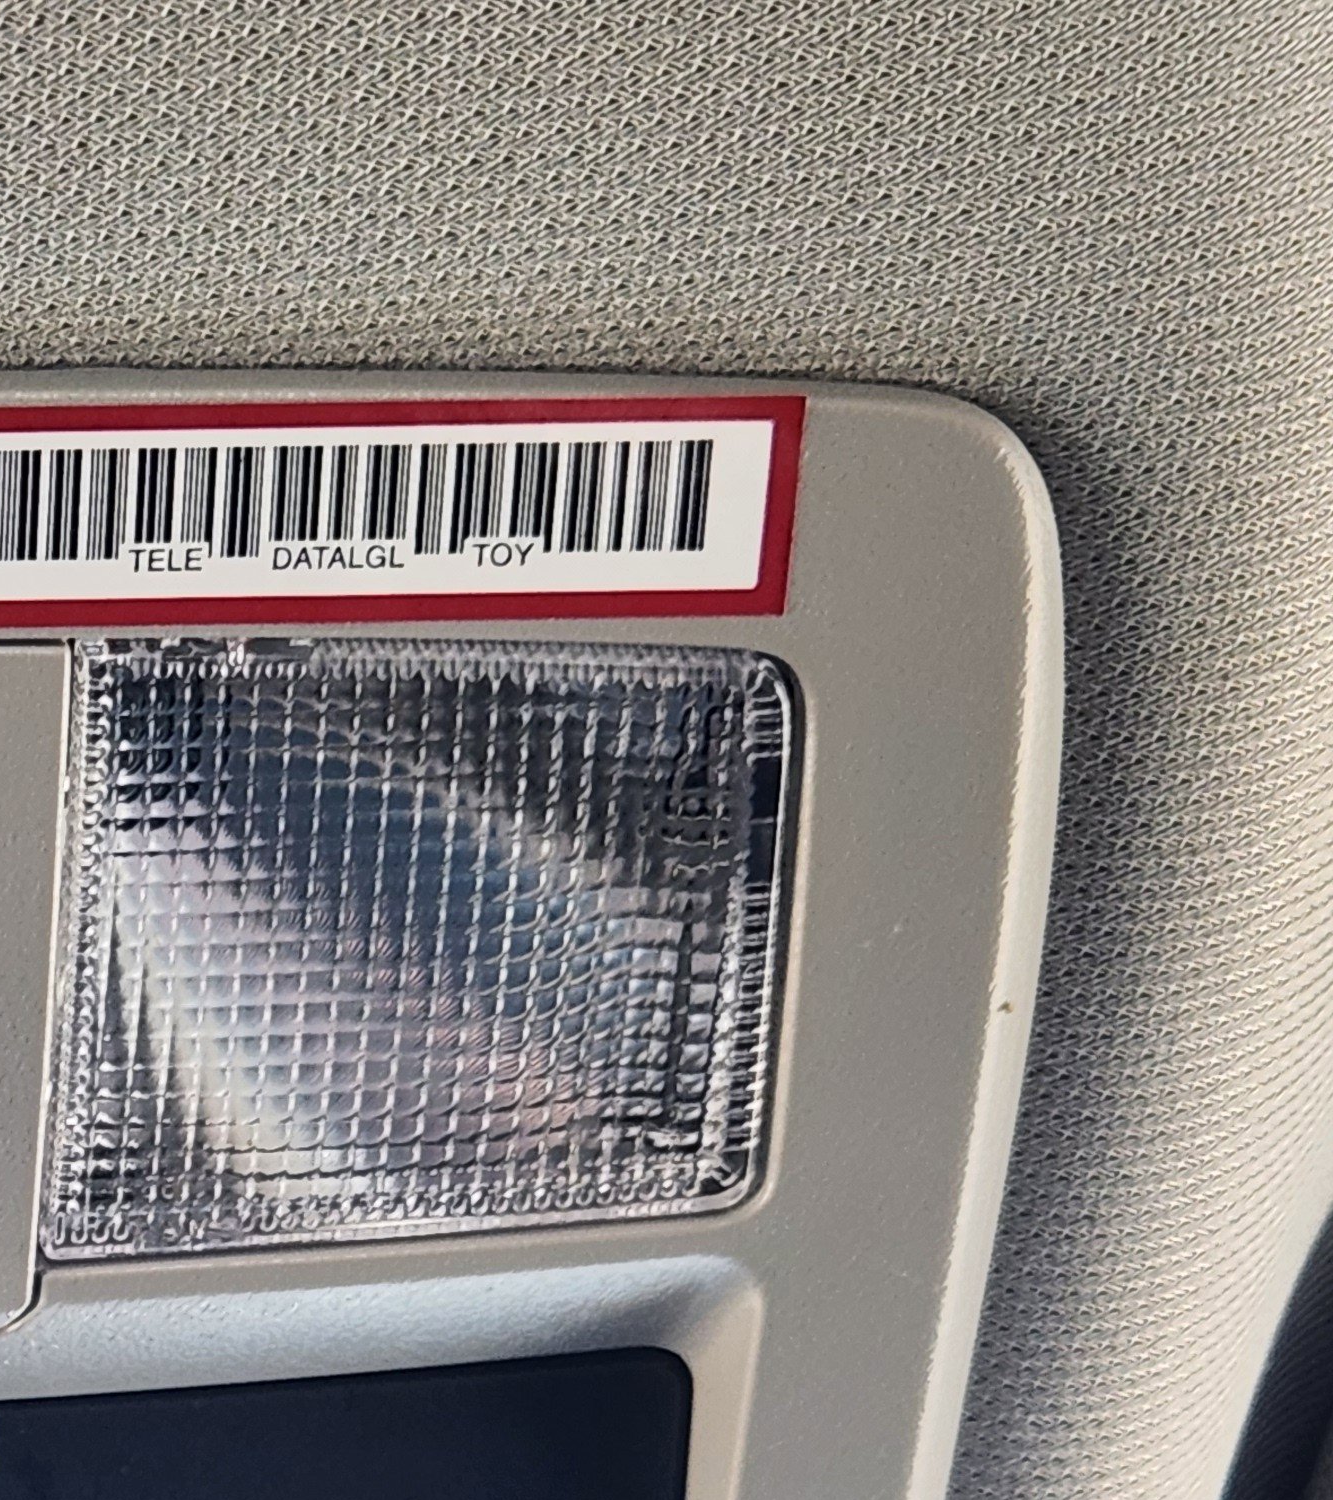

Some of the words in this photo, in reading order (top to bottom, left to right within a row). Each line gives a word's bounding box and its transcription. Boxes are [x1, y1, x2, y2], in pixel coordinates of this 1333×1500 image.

[129, 548, 203, 572] TELE
[272, 544, 405, 571] DATALGL
[472, 543, 535, 567] TOY
